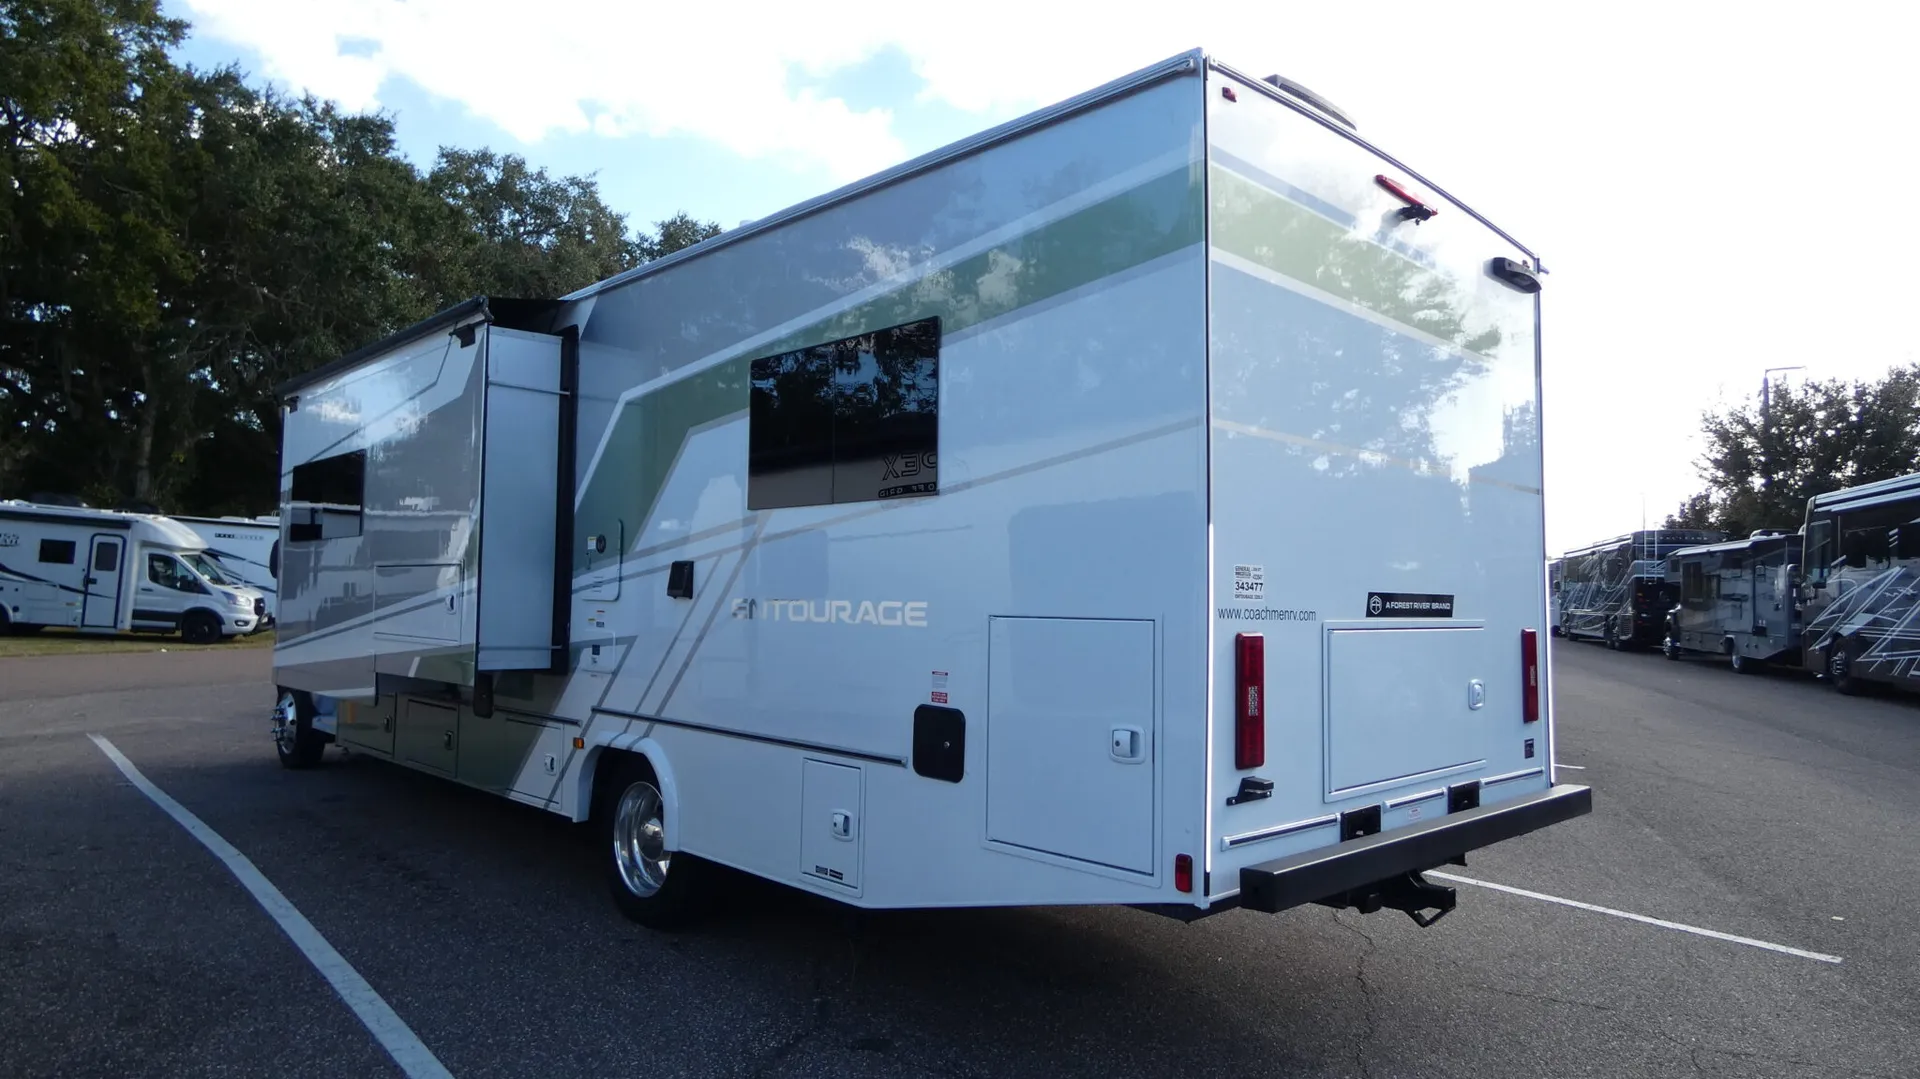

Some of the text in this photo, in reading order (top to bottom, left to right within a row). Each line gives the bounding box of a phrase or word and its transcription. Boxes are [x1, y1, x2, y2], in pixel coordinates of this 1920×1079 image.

[1235, 581, 1264, 592] 343477
[1385, 601, 1451, 610] A FOREST RIVER BRAND
[731, 598, 928, 628] ENTOURAGE
[1218, 606, 1317, 622] www.coachmenrv.com
